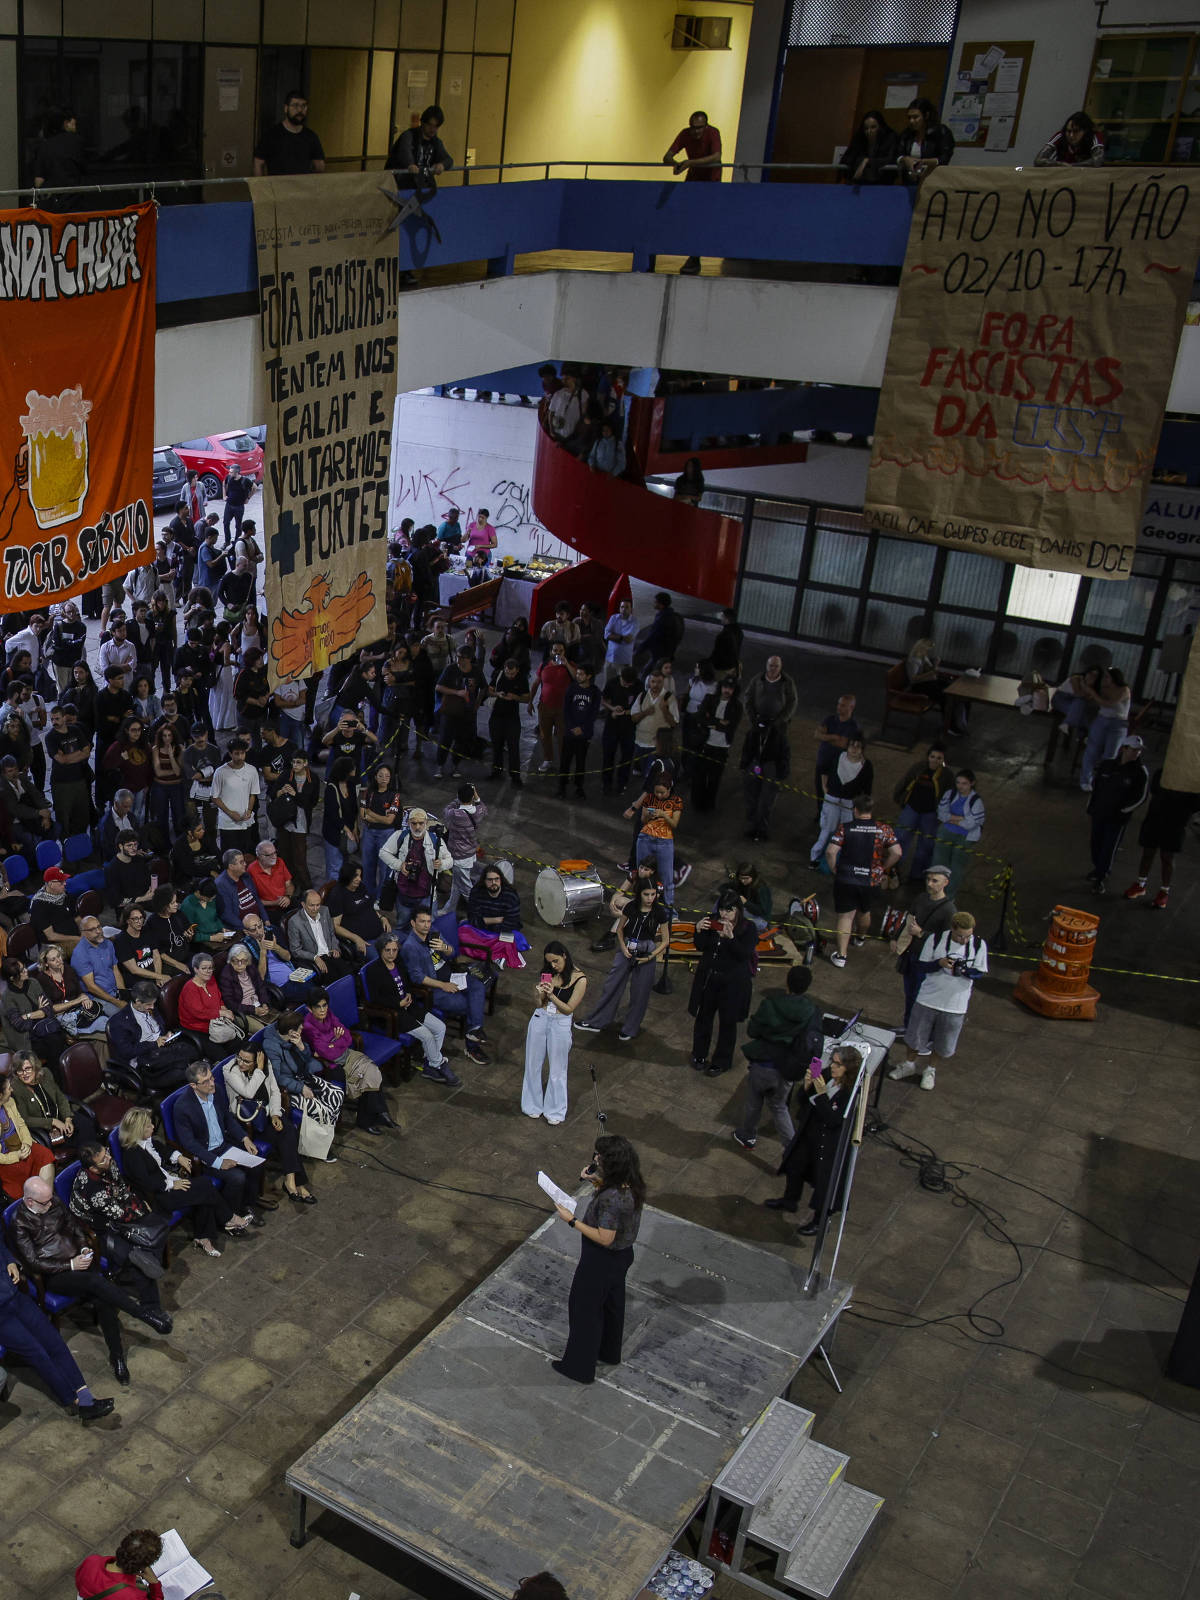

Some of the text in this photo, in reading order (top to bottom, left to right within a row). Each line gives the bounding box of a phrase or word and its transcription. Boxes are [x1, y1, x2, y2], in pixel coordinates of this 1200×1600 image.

[920, 173, 1191, 243] ATO NO VÃO
[980, 312, 1074, 354] FORA
[265, 336, 398, 402] TENTEM NOS
[920, 347, 1125, 406] FASCISTAS
[369, 390, 385, 425] E
[933, 395, 998, 439] DA
[270, 431, 391, 506] VOLTAREMOS
[303, 480, 389, 567] FORTES
[907, 516, 938, 535] CAF
[1087, 540, 1133, 572] DCE
[4, 535, 74, 600] TOCAR
